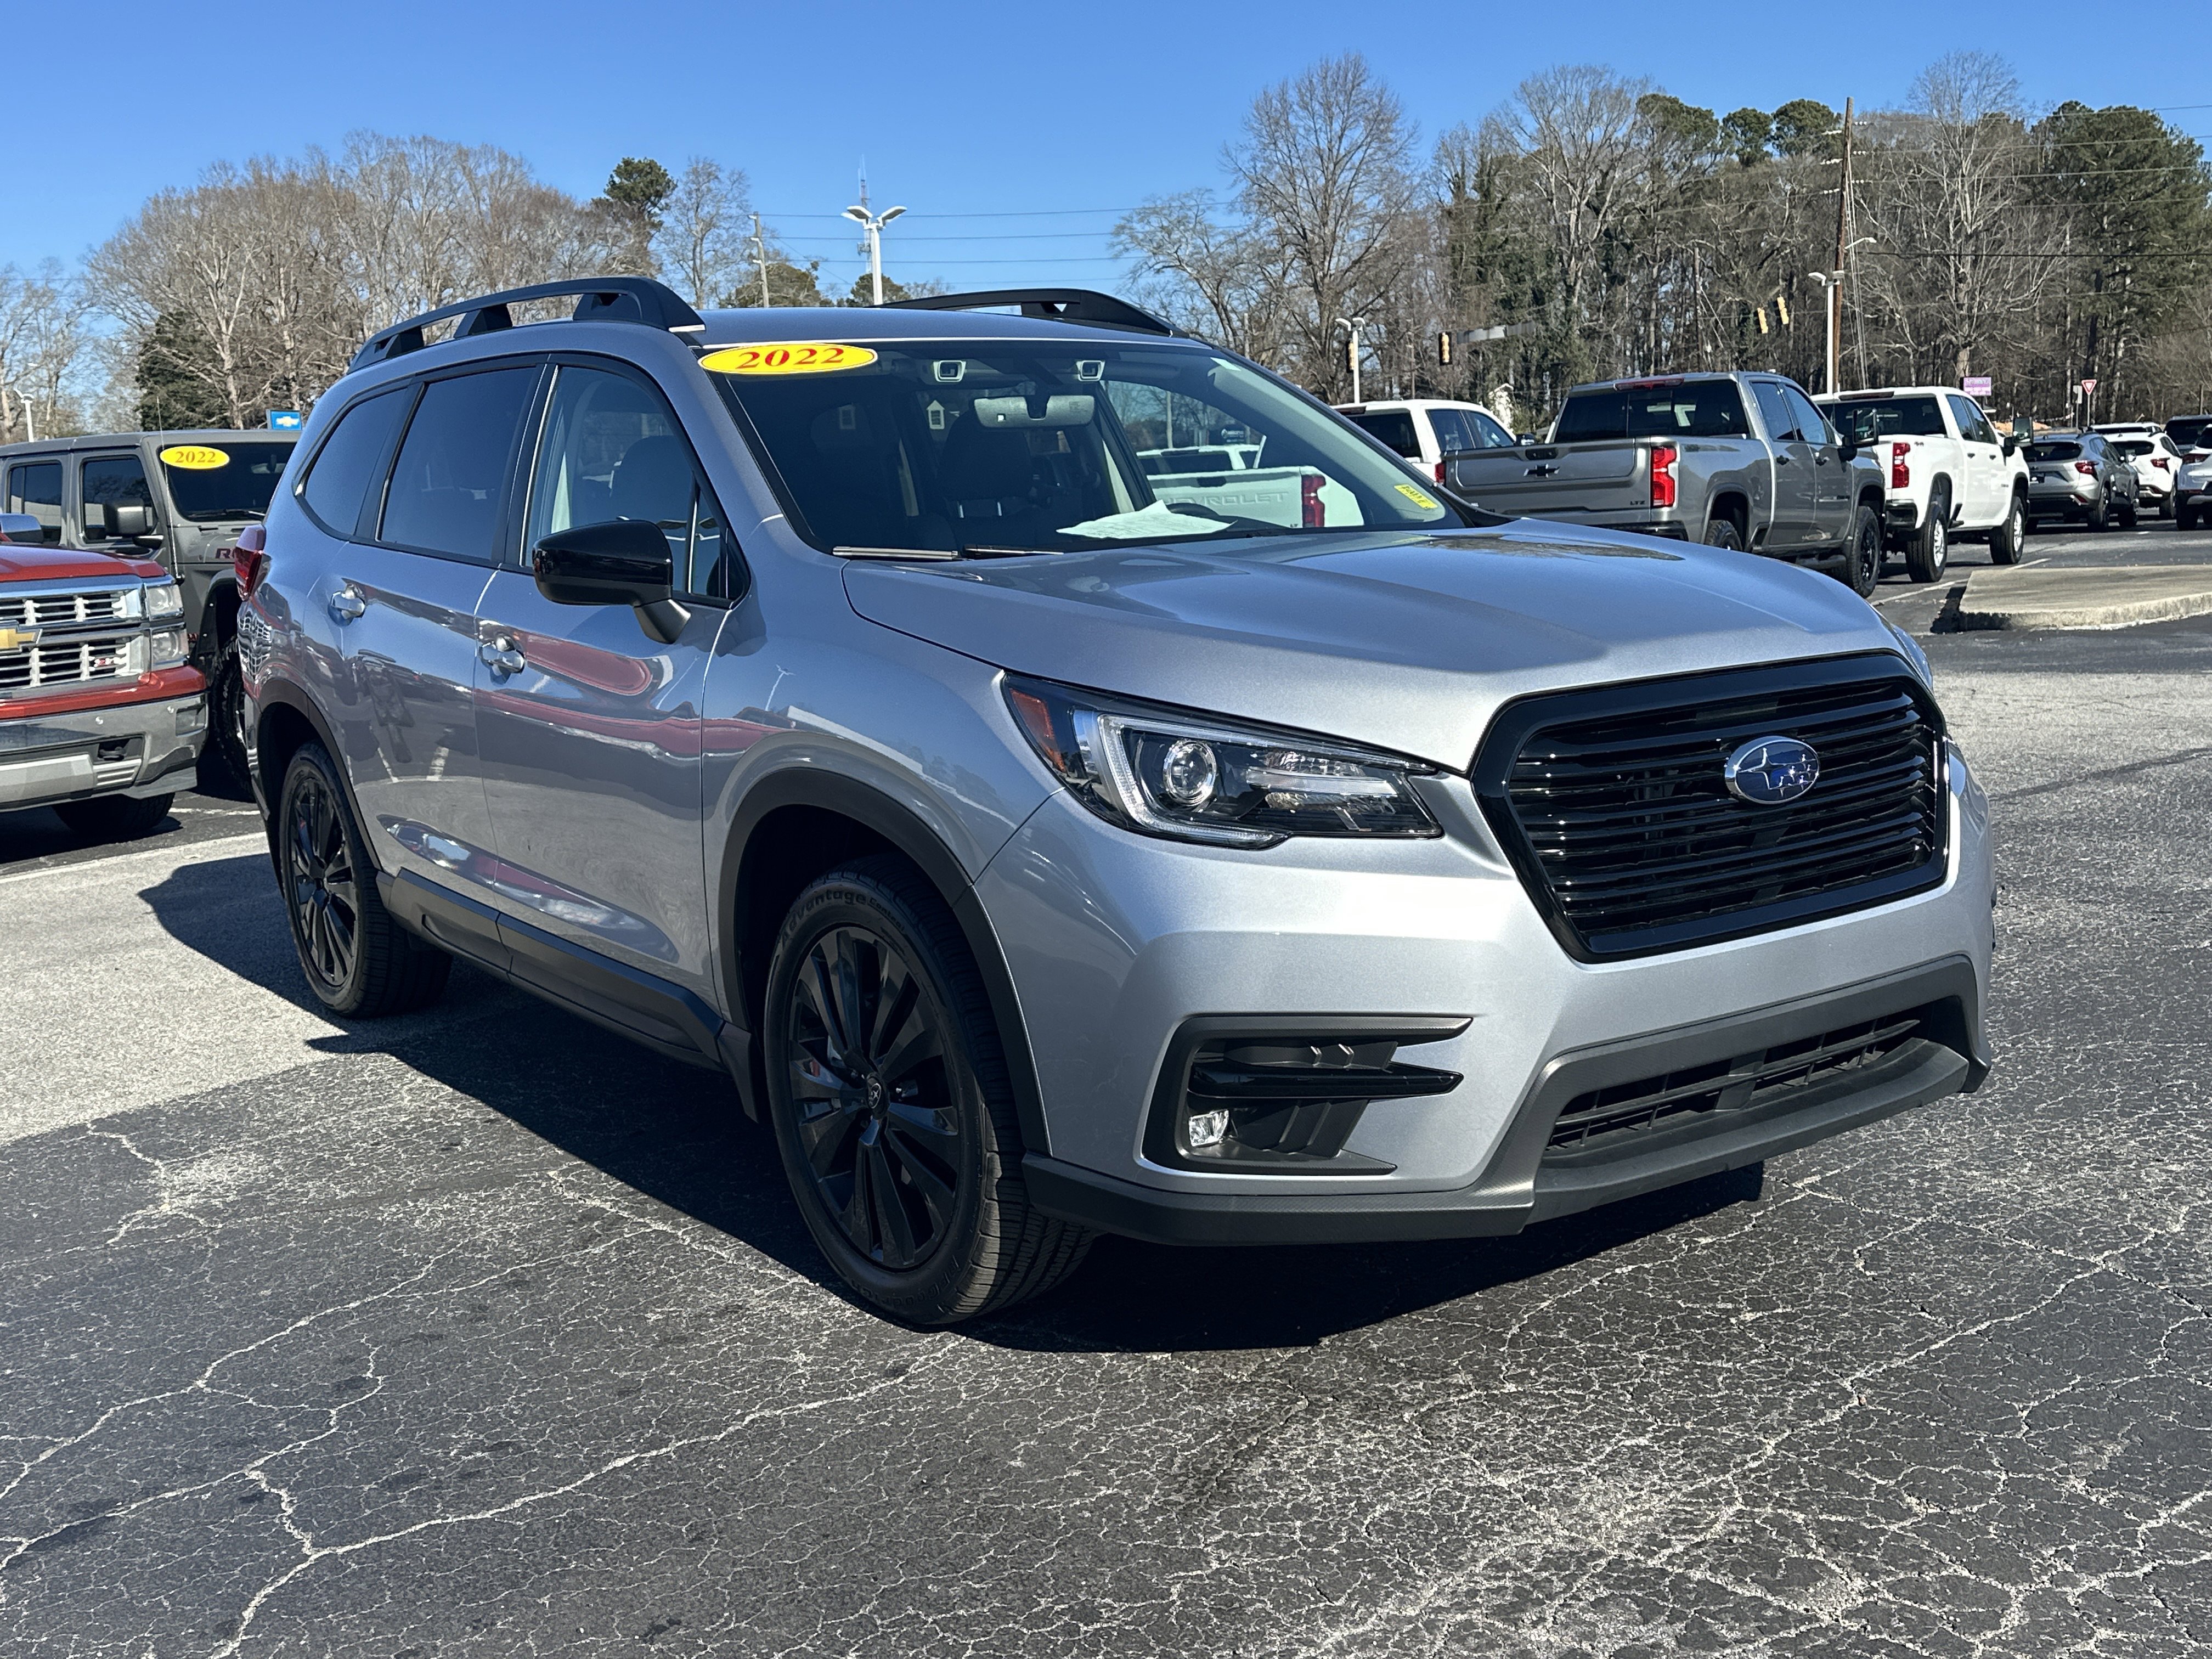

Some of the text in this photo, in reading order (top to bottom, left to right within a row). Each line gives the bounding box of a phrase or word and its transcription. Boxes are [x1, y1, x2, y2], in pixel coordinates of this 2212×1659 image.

[735, 347, 844, 369] 2022
[175, 450, 216, 463] 2022
[781, 889, 866, 950] Advantage
